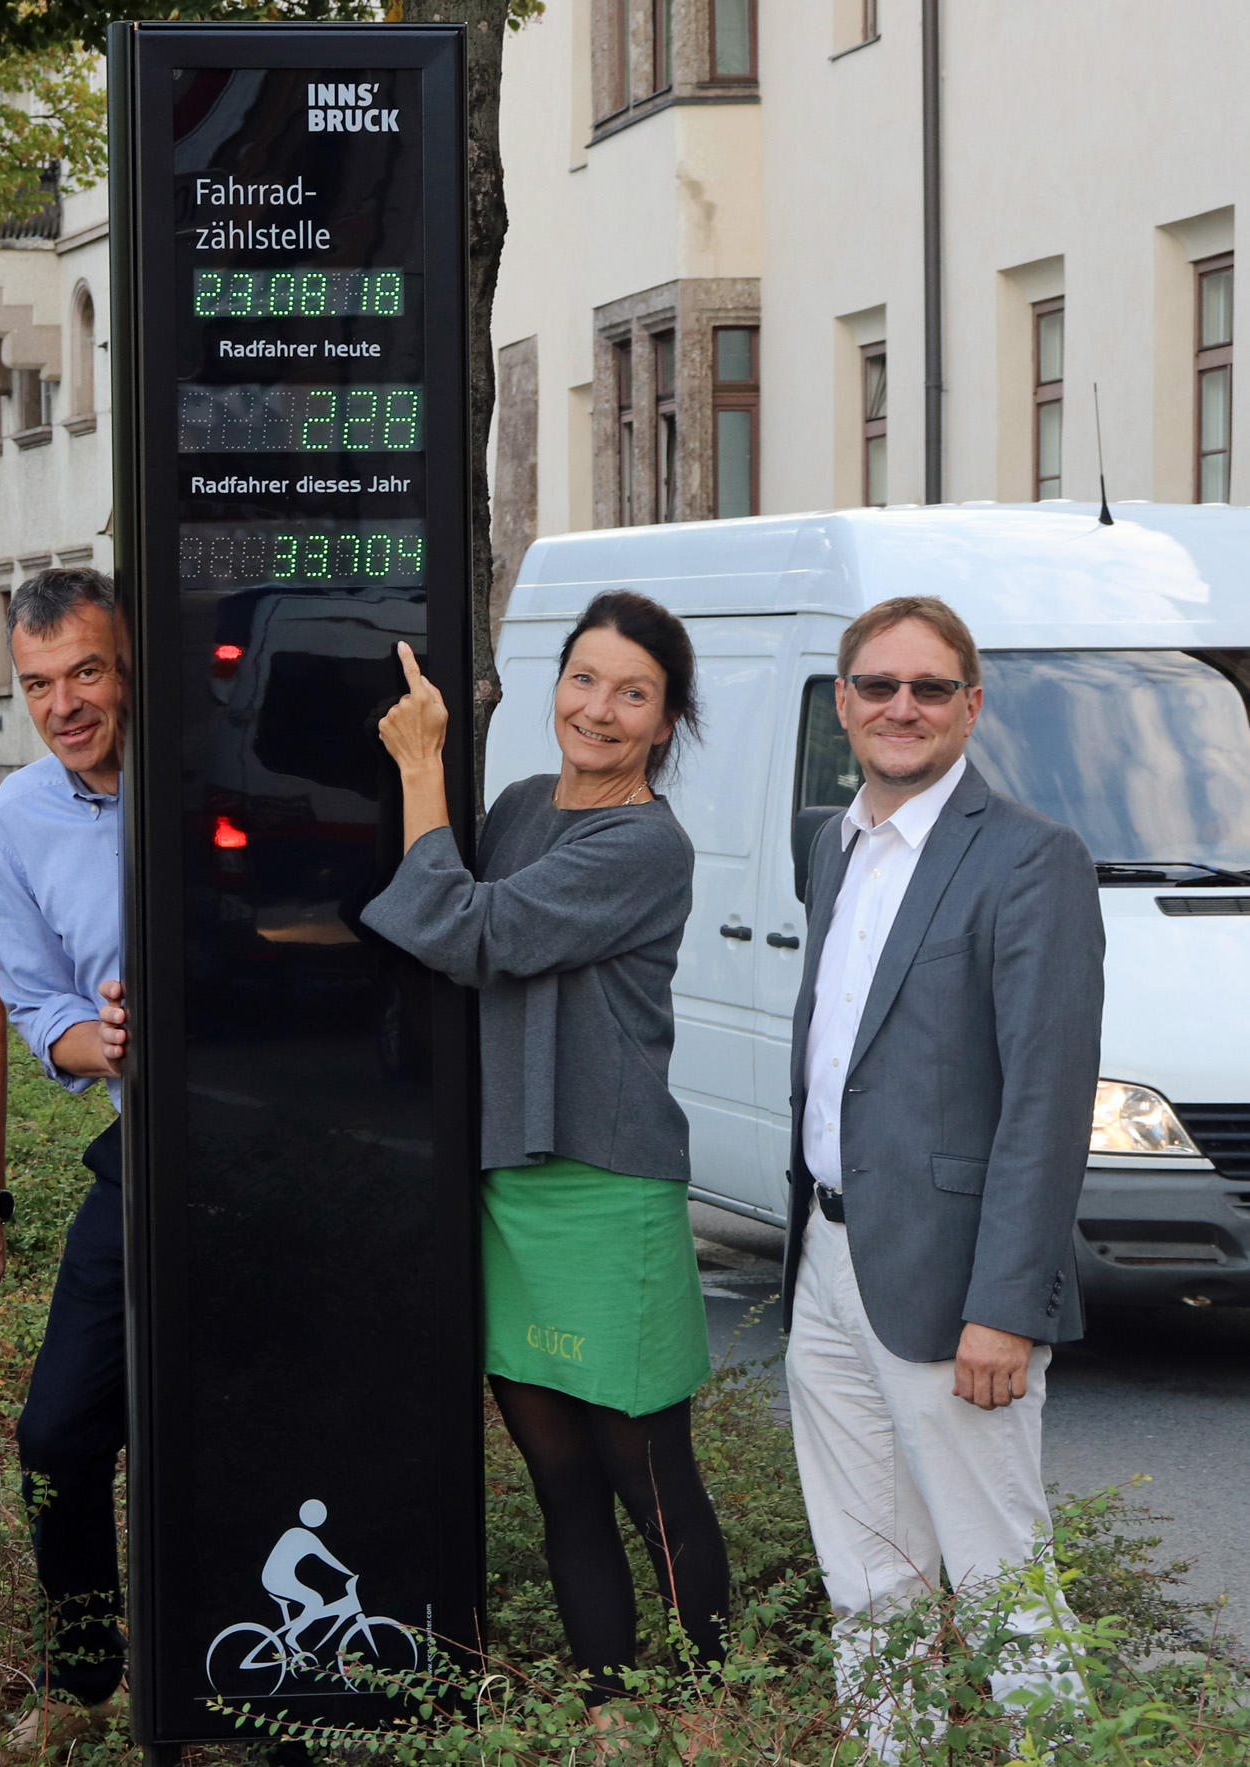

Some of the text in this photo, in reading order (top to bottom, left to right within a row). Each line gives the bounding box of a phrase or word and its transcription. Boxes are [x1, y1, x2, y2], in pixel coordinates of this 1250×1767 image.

[307, 109, 400, 132] BRUCK
[195, 175, 317, 205] Fahrrad-
[195, 220, 331, 249] zählstelle
[219, 340, 382, 358] Radfahrer heute
[301, 390, 419, 450] 228
[191, 475, 411, 494] Radfahrer dieses Jahr
[272, 534, 423, 579] 33.704
[527, 1324, 586, 1362] GLÜCK
